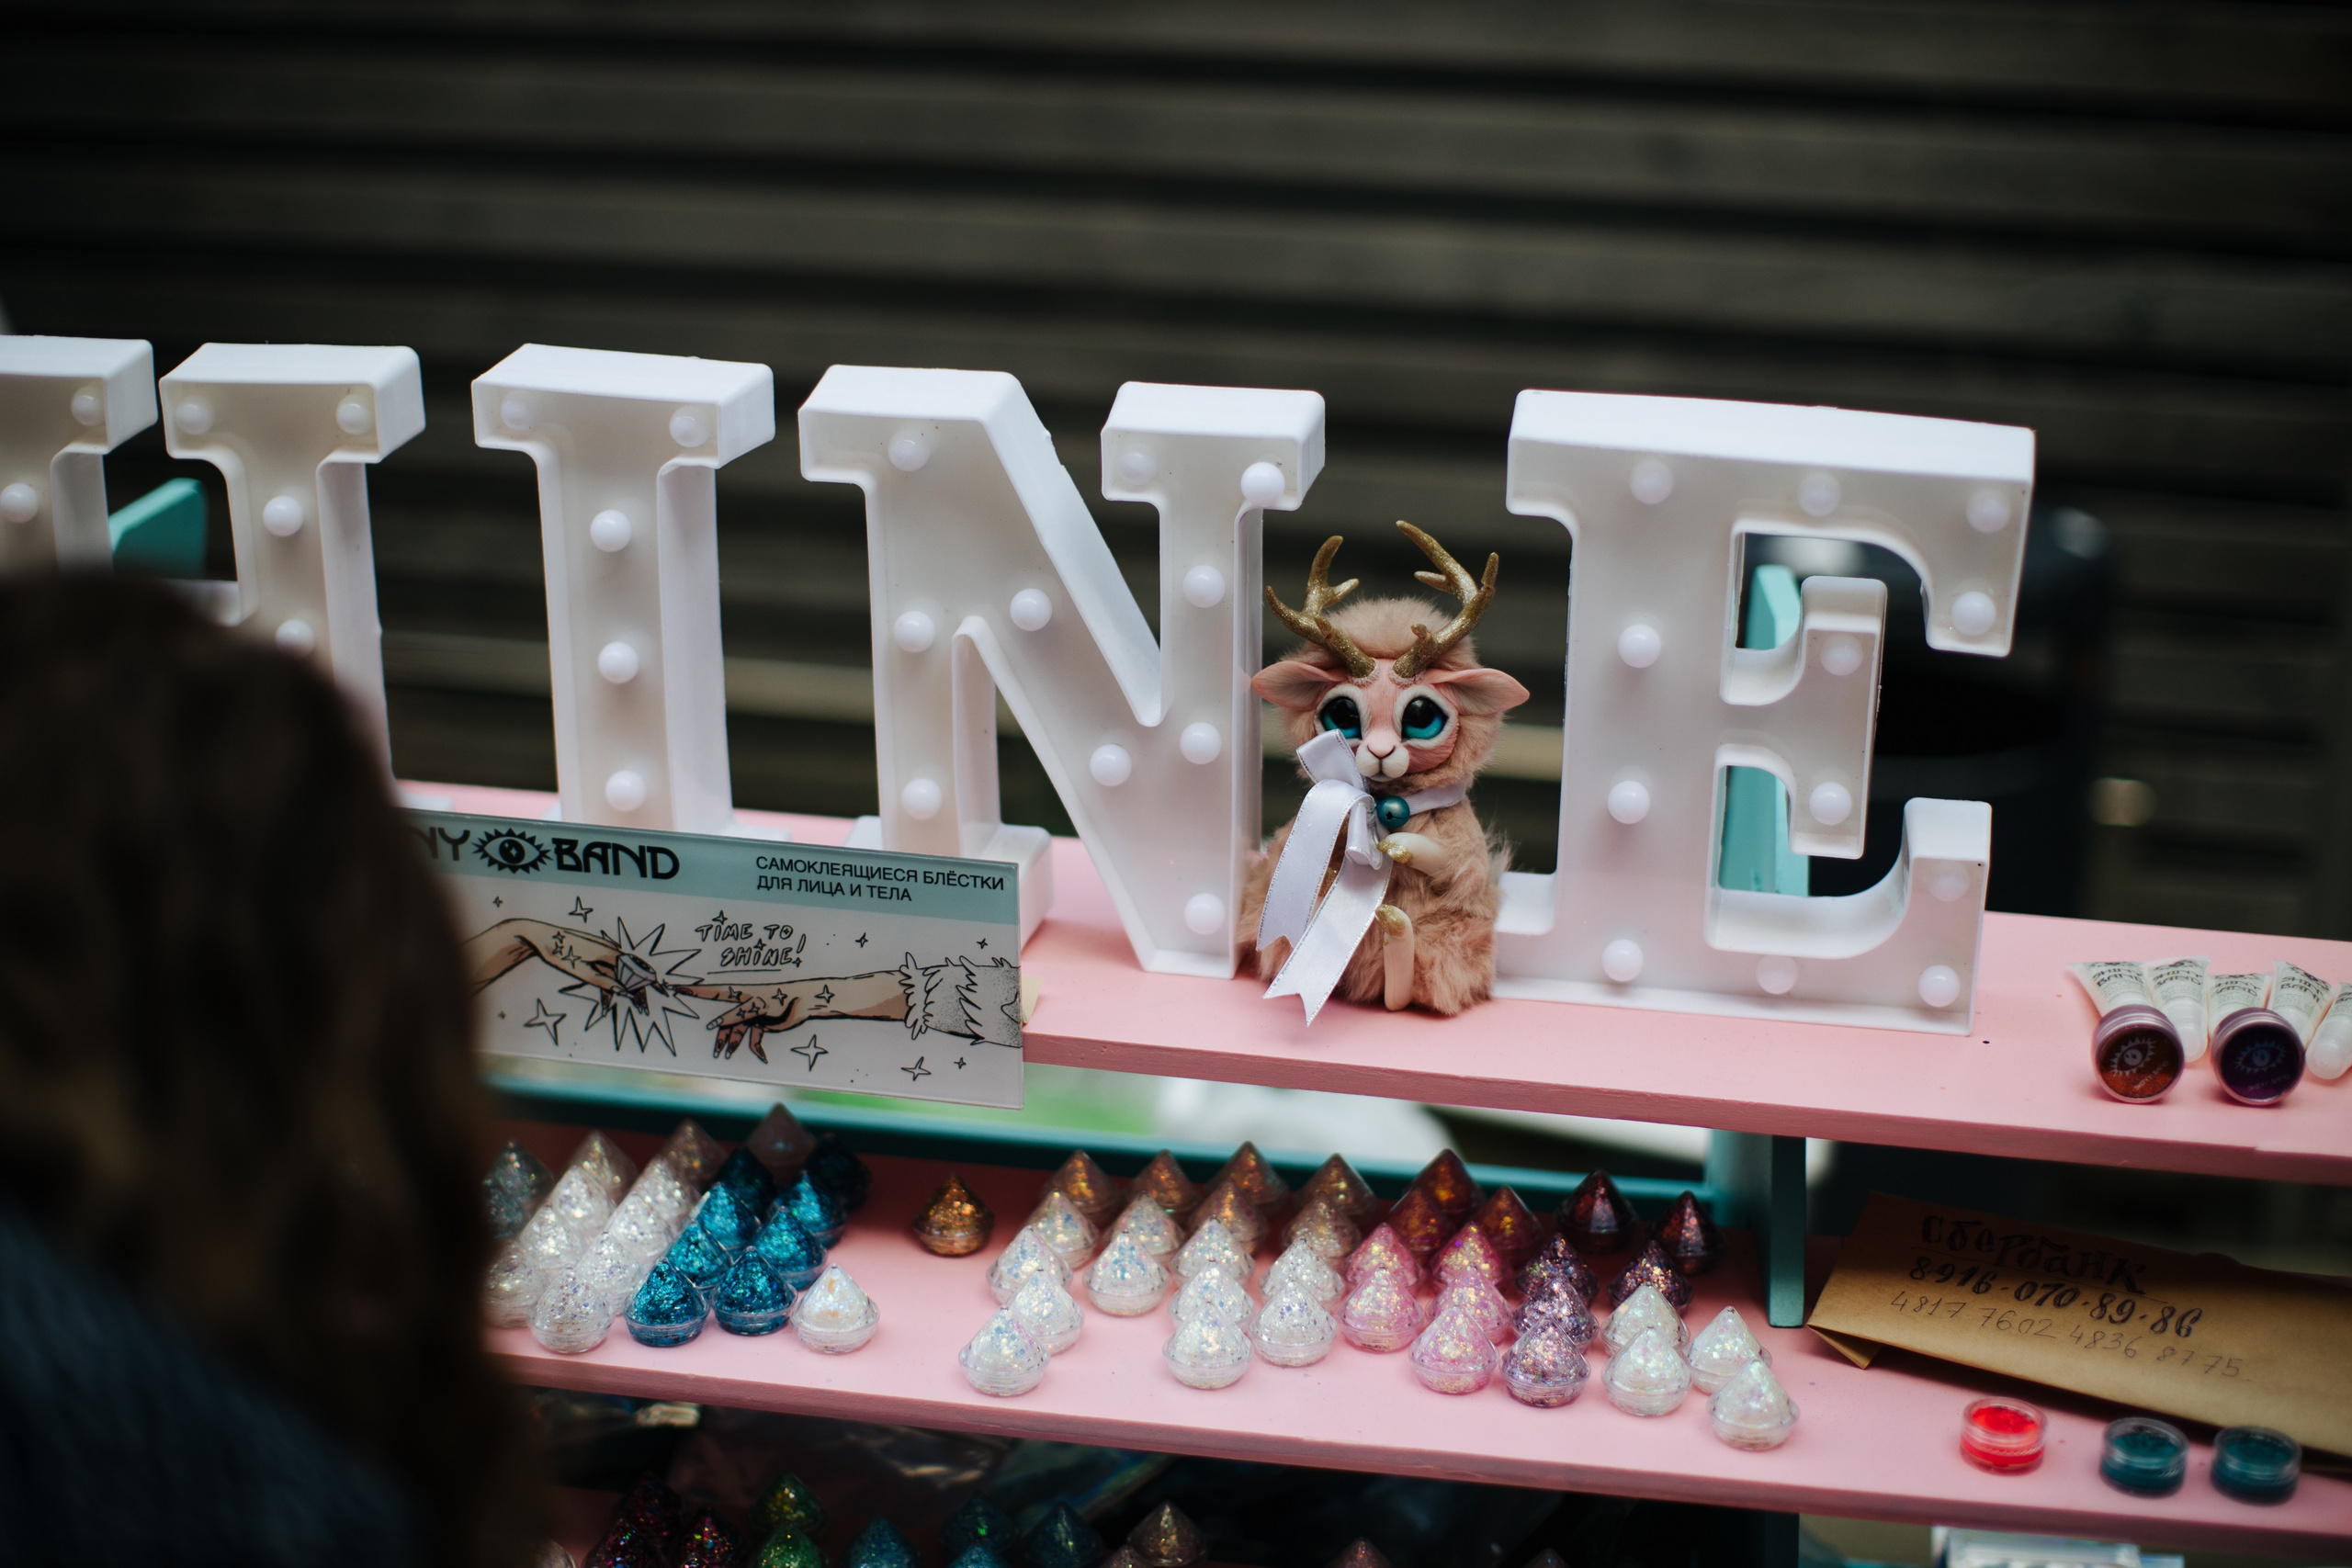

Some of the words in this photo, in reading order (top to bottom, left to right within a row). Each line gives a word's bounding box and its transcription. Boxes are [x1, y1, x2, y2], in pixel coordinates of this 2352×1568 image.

[552, 837, 680, 880] BAND
[756, 856, 918, 883] САМОКЛЕЯЩИЕСЯ
[923, 870, 1005, 891] БЛЁСТКИ
[757, 875, 792, 891] ДЛЯ
[797, 879, 845, 897] ЛИЦА
[851, 884, 862, 897] И
[866, 885, 912, 902] ТЕЛА
[695, 922, 753, 942] TIME
[763, 924, 794, 940] TO
[720, 933, 807, 967] SHINE!
[1890, 1291, 1967, 1318] 4817
[1978, 1307, 2057, 1339] 7602
[2069, 1325, 2143, 1359] 4836
